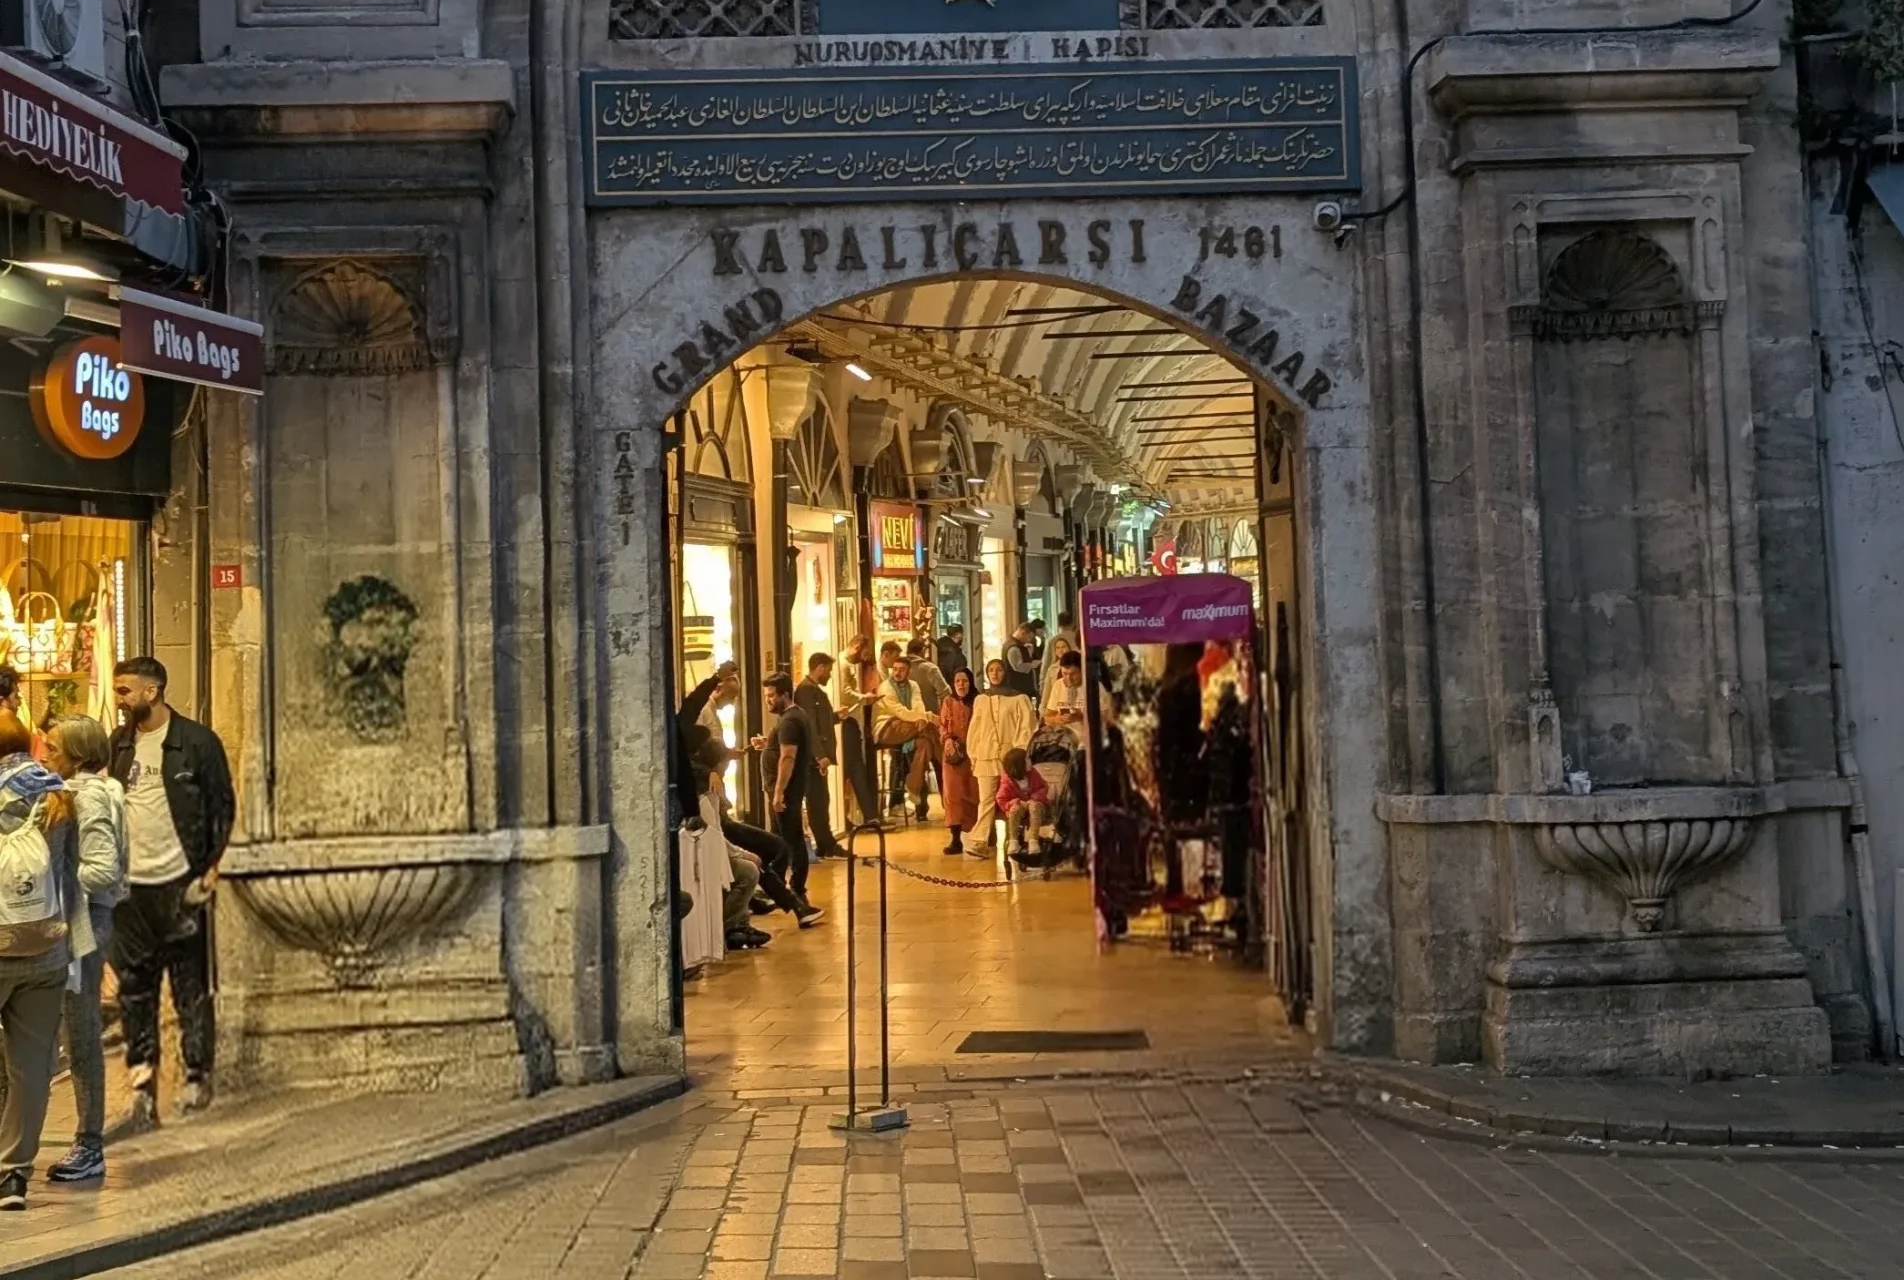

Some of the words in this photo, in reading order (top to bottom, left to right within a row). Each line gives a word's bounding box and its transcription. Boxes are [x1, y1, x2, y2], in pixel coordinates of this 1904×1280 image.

[1052, 34, 1150, 59] KAPISI
[2, 89, 124, 185] HEDİYELİK
[710, 219, 1147, 276] KAPALIÇARŞI
[1200, 224, 1283, 262] 1461
[153, 319, 193, 363] Piko
[197, 330, 241, 379] Bags
[653, 286, 784, 395] GRAND
[1170, 274, 1331, 408] BAZAAR
[75, 352, 130, 401] Piko
[81, 400, 120, 440] Bags
[614, 431, 635, 515] GATE
[220, 570, 235, 583] 15
[1089, 603, 1141, 616] Fırsatlar
[1089, 617, 1165, 629] Maximum'da!
